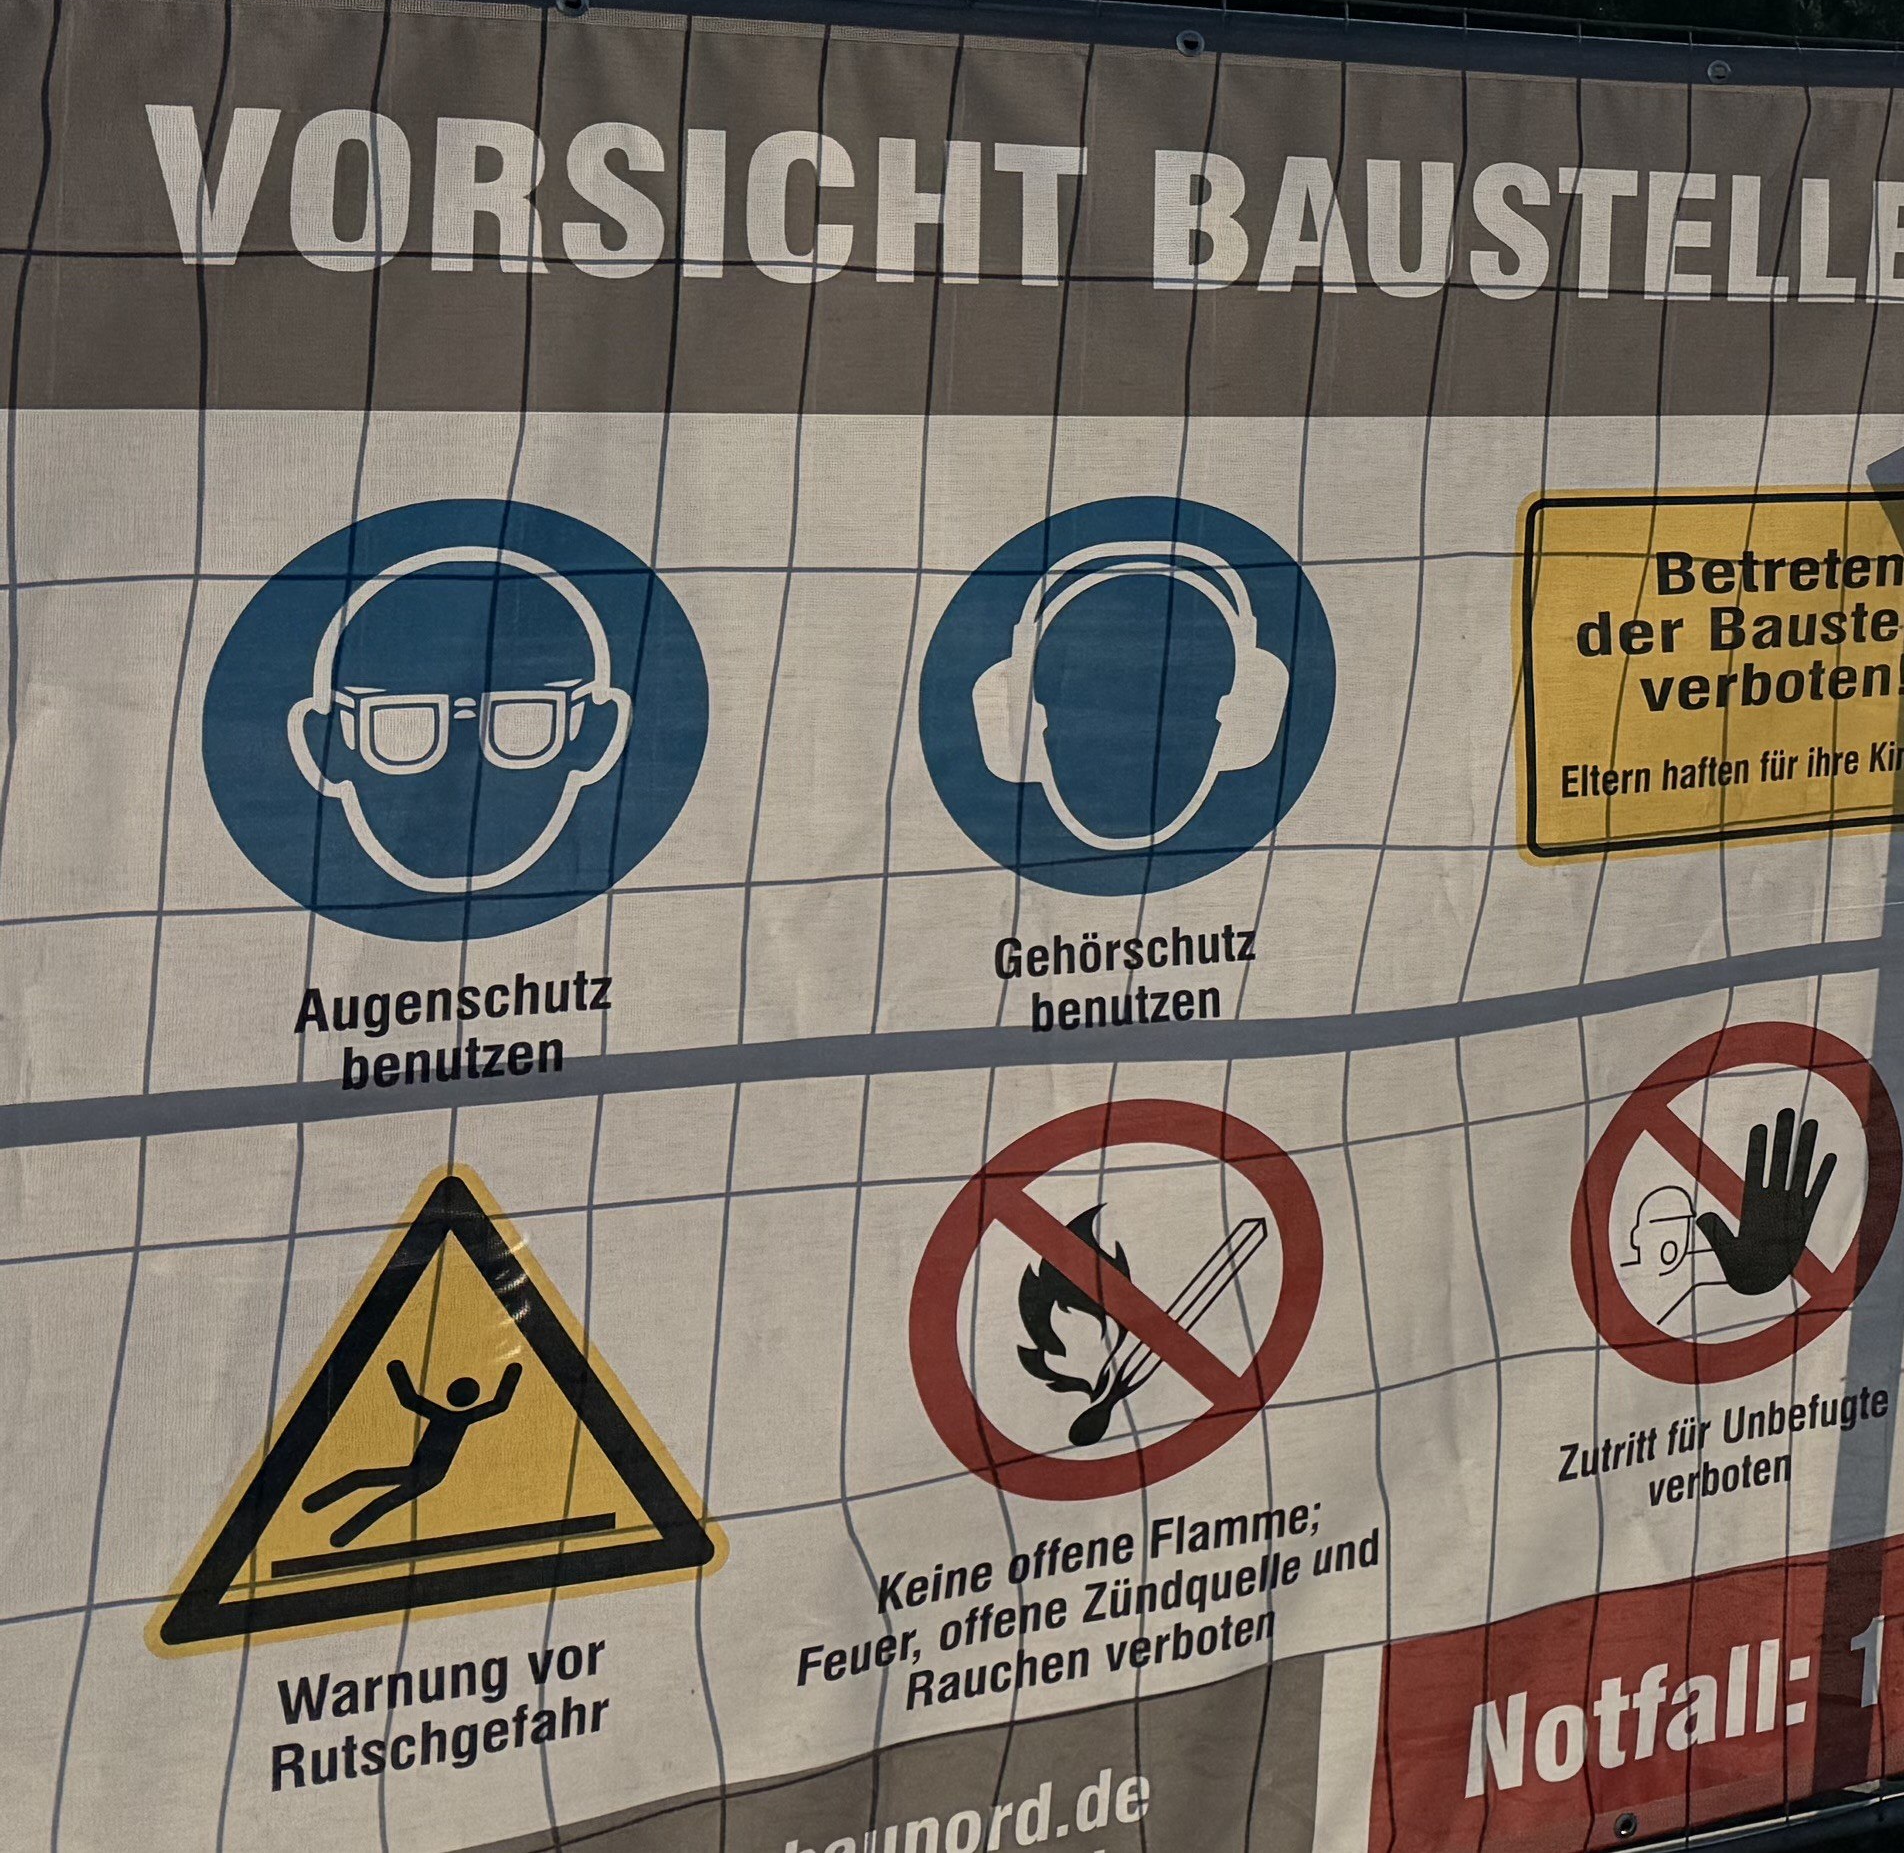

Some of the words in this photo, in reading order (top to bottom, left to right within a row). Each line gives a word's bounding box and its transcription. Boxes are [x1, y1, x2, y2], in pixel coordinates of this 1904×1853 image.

[145, 104, 1089, 286] VORSICHT
[1656, 548, 1904, 596] Betreten
[1576, 610, 1685, 658] der
[1560, 763, 1652, 799] Eltern
[1661, 753, 1750, 792] haften
[1760, 749, 1799, 783] für
[1807, 746, 1860, 780] ihre
[993, 924, 1258, 982] Gehörschutz
[294, 971, 614, 1036] Augenschutz
[1029, 982, 1222, 1034] benutzen
[340, 1036, 565, 1092] benutzen
[1557, 1428, 1659, 1485] Zutritt
[1667, 1412, 1711, 1458] für
[1722, 1385, 1891, 1446] Unbefugte
[1648, 1450, 1793, 1507] verboten
[876, 1557, 993, 1614] Keine
[1007, 1528, 1135, 1586] offene
[1150, 1500, 1323, 1561] Flamme;
[796, 1625, 923, 1687] Feuer,
[939, 1591, 1068, 1652] offene
[1082, 1551, 1302, 1624] Zündquelle
[1312, 1527, 1381, 1579] und
[277, 1655, 509, 1725] Warnung
[527, 1639, 607, 1686] vor
[905, 1647, 1091, 1711] Rauchen
[1105, 1609, 1276, 1675] verboten
[270, 1693, 611, 1793] Rutschgefahr
[1463, 1636, 1812, 1800] Notfall:
[784, 1768, 1151, 1853] unord.de
